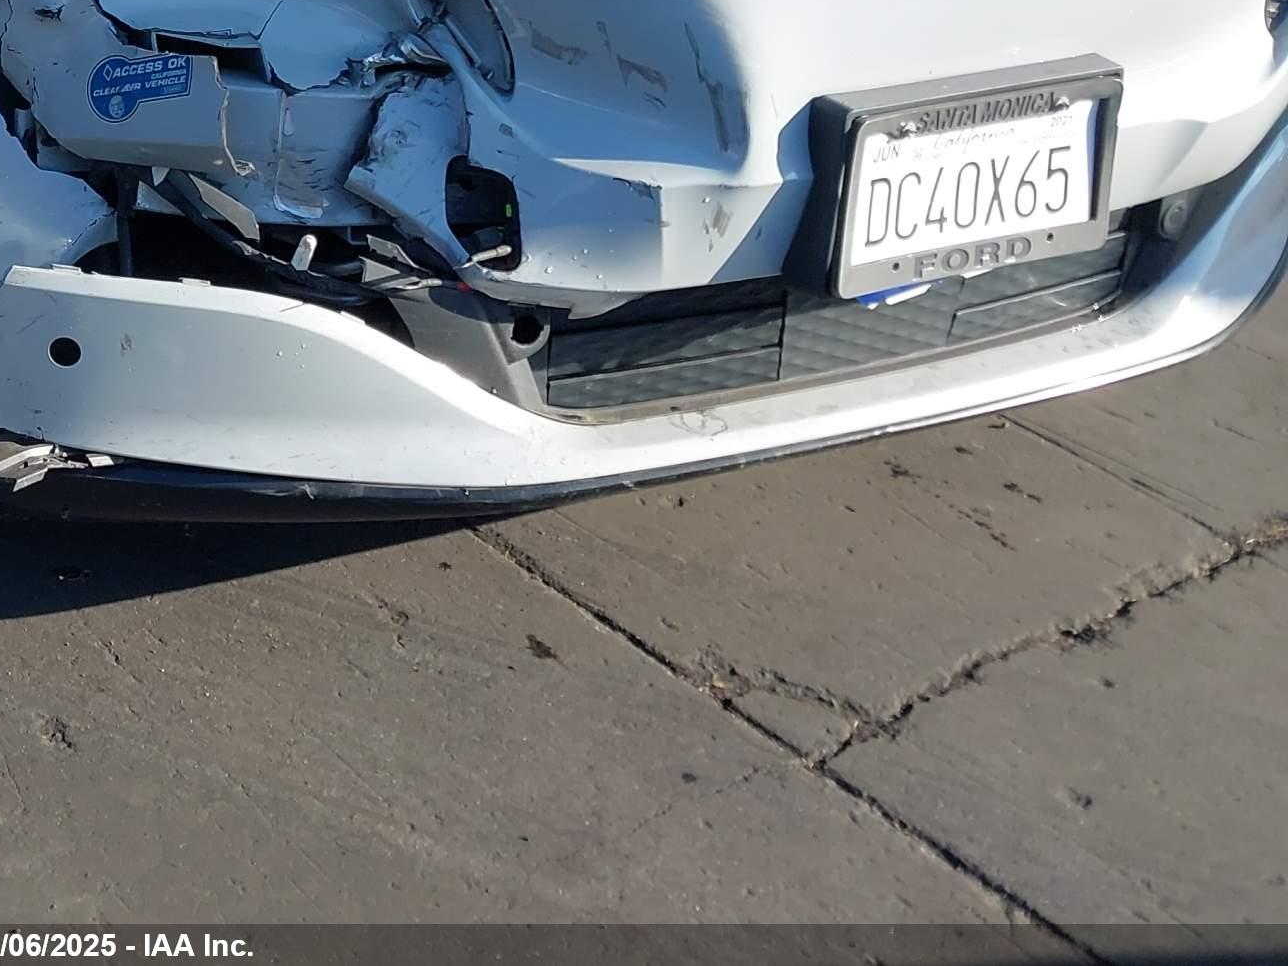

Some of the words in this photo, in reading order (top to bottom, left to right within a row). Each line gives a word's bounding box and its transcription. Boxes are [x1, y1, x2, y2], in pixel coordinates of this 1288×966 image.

[113, 61, 162, 77] ACCESS
[168, 57, 186, 68] OK
[145, 76, 186, 89] VEHICLE
[916, 109, 977, 132] SANTA
[980, 91, 1055, 124] MONICA
[873, 144, 901, 163] JUN
[913, 237, 1031, 281] FORD
